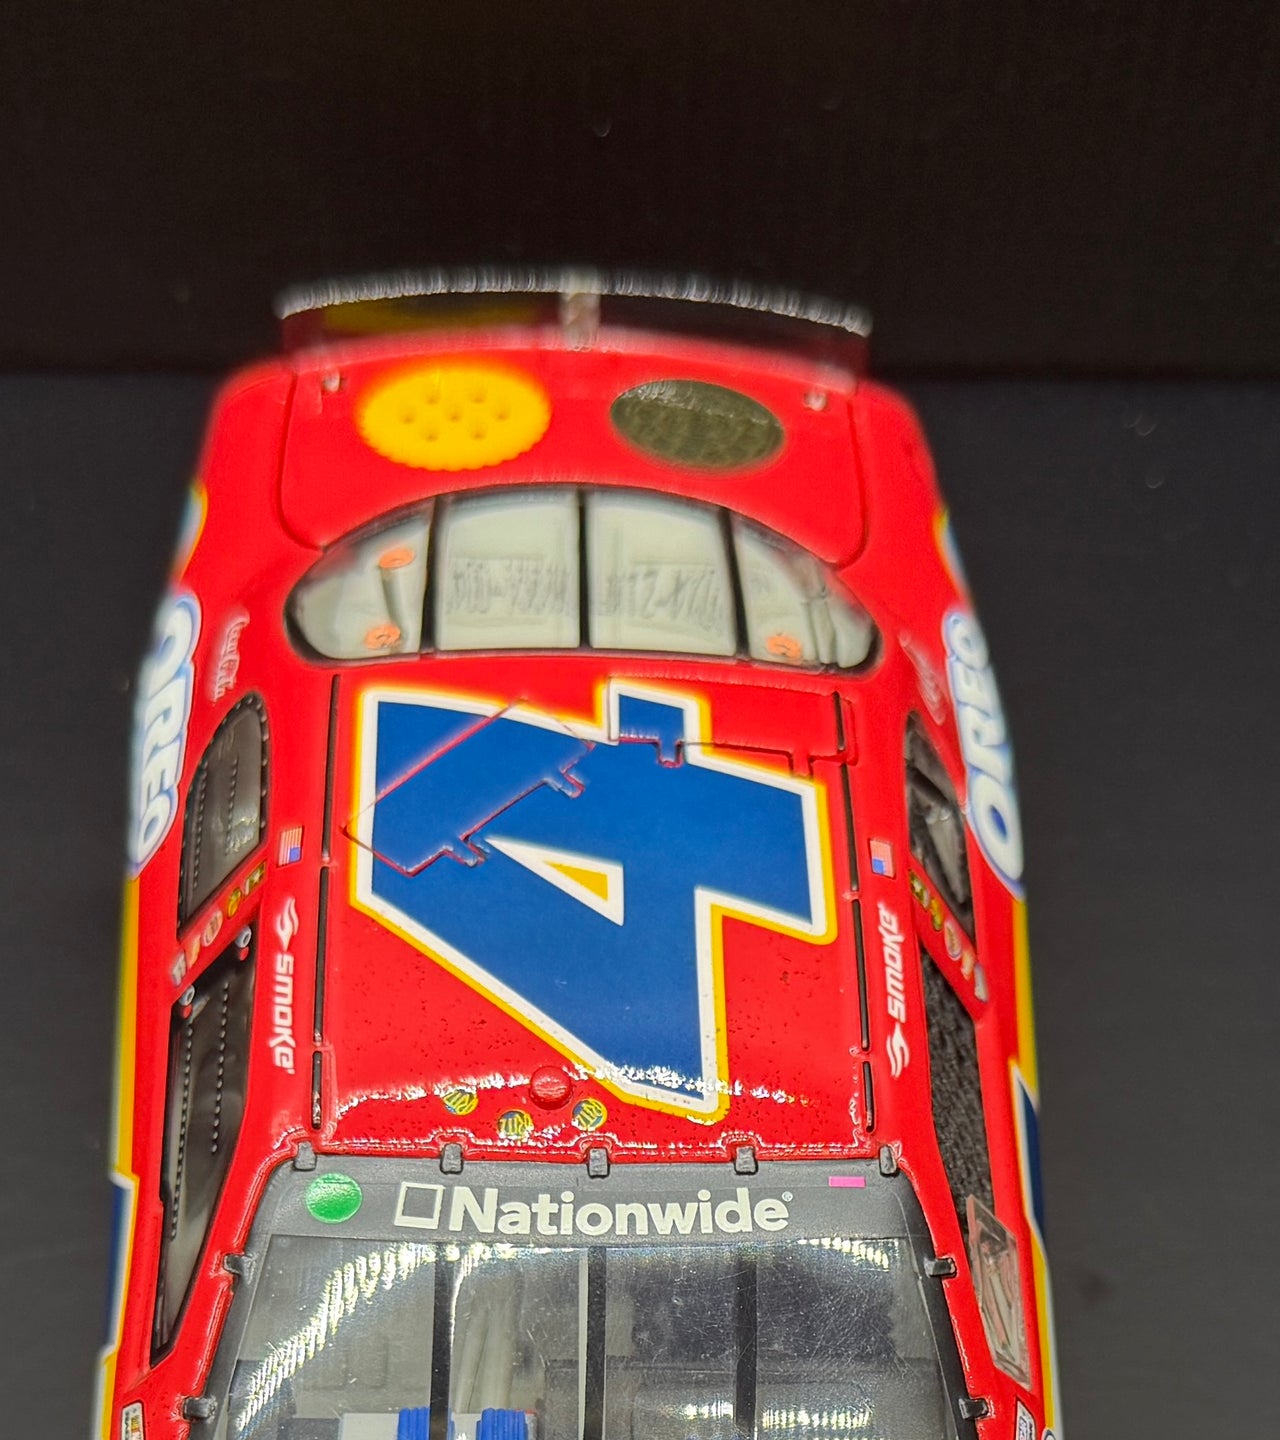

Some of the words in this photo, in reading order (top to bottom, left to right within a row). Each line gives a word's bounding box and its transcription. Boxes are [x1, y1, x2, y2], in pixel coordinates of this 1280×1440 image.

[133, 601, 193, 864] OREO
[946, 614, 1024, 881] OREO
[358, 677, 827, 1112] 4
